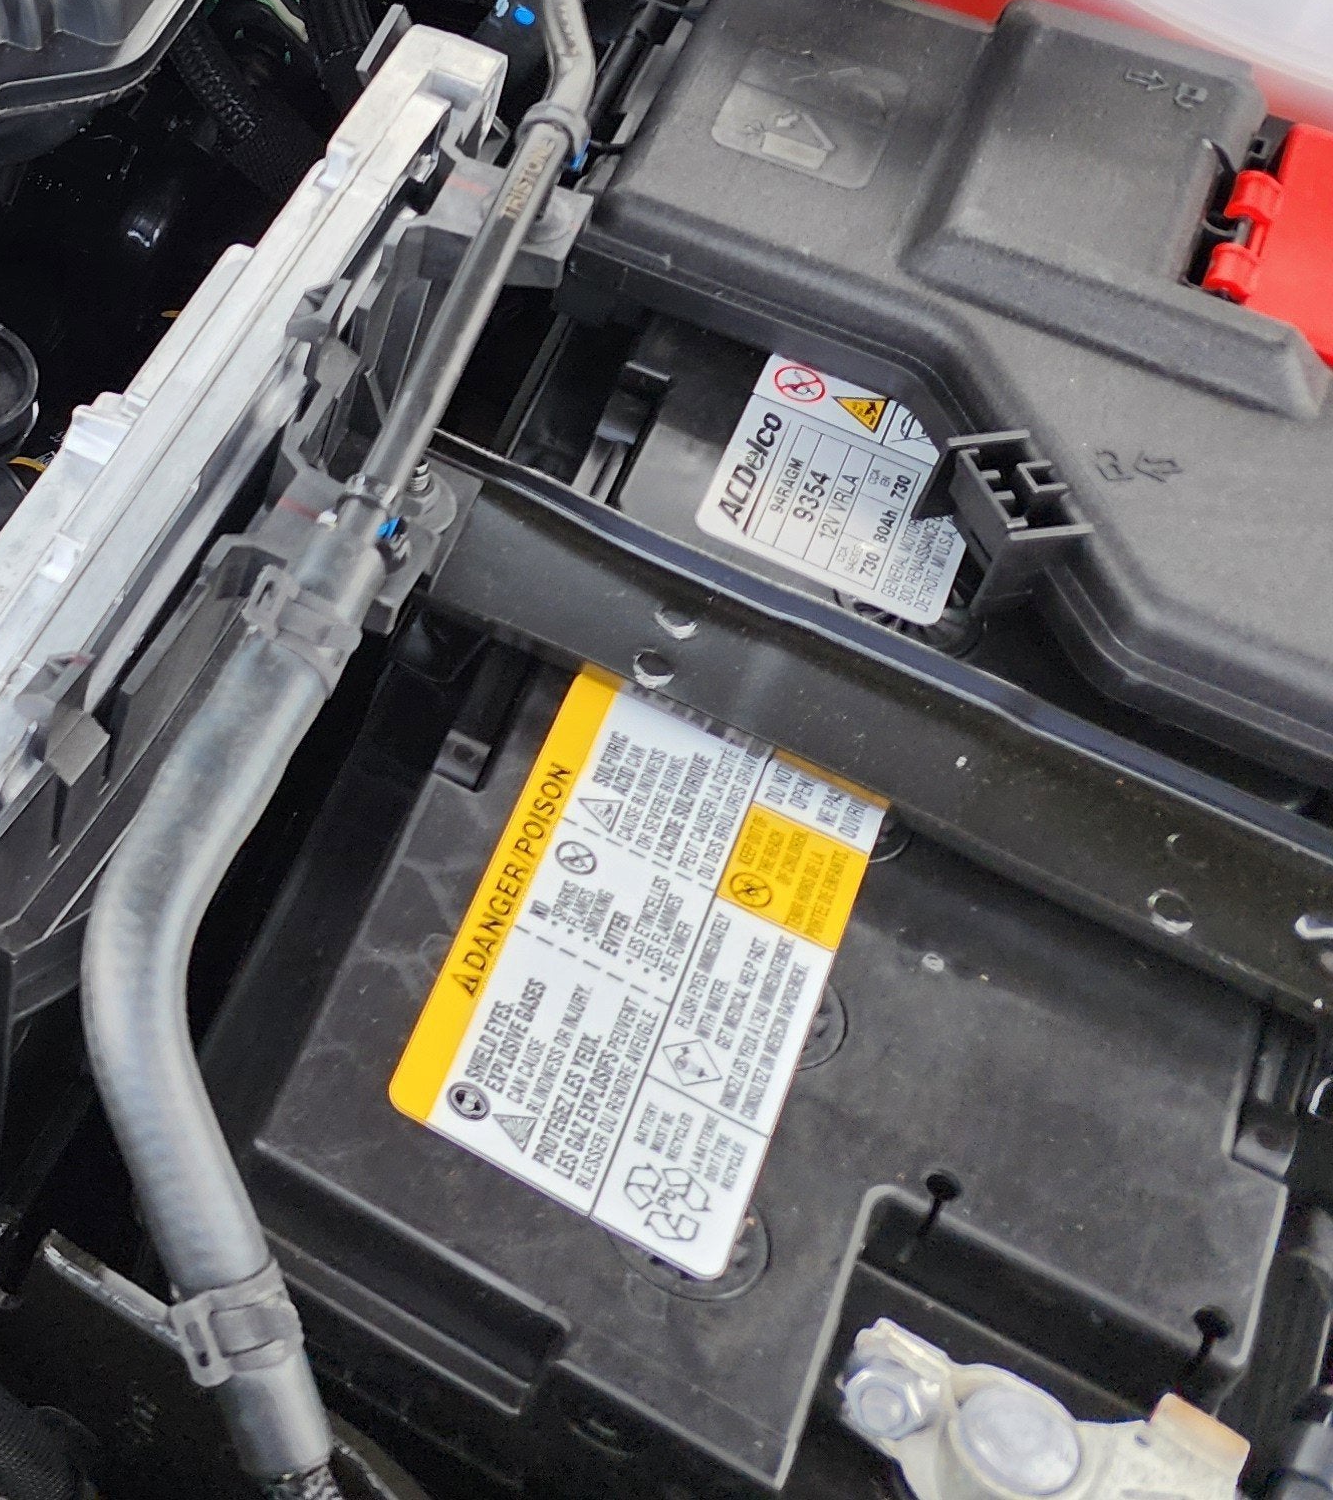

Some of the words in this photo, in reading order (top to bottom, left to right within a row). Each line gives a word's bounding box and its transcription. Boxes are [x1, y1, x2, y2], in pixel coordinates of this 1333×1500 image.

[713, 407, 783, 525] ACDelco
[768, 455, 804, 515] 94RAGM
[791, 467, 831, 524] 9354
[829, 470, 860, 513] VRLA
[889, 472, 912, 502] 730
[818, 514, 842, 542] 12V
[873, 507, 898, 545] 80Ah
[858, 549, 881, 580] 730
[880, 550, 908, 599] GENERAL
[897, 516, 919, 554] MOTOR
[904, 518, 941, 587] RENAISSANCE
[928, 551, 948, 569] MI
[897, 580, 917, 606] 300
[590, 729, 629, 788] SULFURIC
[622, 742, 647, 769] CAN
[733, 749, 760, 786] GRAV
[610, 765, 637, 797] ACID
[615, 803, 644, 842] CAUSE
[630, 746, 668, 808] BLINDNESS
[670, 752, 712, 821] SULFURIQUE
[706, 781, 725, 801] LA
[764, 784, 786, 805] DO
[642, 790, 672, 835] SEVERE
[688, 798, 719, 844] CAUSER
[815, 806, 838, 827] NE
[837, 796, 868, 840] OUVRI
[635, 830, 656, 851] OR
[677, 840, 702, 872] PEUT
[702, 838, 725, 864] DES
[462, 761, 572, 973] DANGER/POISON
[696, 860, 717, 881] OU
[549, 879, 580, 922] SPARKS
[565, 886, 596, 930] FLAMES
[582, 888, 615, 938] SMOKING
[650, 892, 685, 947] FLAMMES
[624, 935, 647, 960] LES
[641, 943, 664, 970] LES
[665, 918, 694, 961] FUMER
[658, 955, 679, 978] DE
[686, 970, 709, 999] EYES
[737, 959, 760, 989] HELP
[606, 995, 642, 1053] PEUVENT
[674, 994, 699, 1031] FLUSH
[694, 1010, 717, 1041] WITH
[721, 984, 751, 1030] MEDICAL
[463, 1032, 500, 1085] SHIELD
[483, 995, 515, 1038] EYES.
[483, 1018, 530, 1095] EXPLOSIVE
[513, 976, 547, 1023] GASES
[714, 1026, 735, 1051] GET
[516, 1035, 547, 1079] CAUSE
[524, 1045, 567, 1117] BLINDNESS
[552, 1026, 574, 1050] OR
[505, 1075, 530, 1106] CAN
[559, 1067, 586, 1099] LES
[575, 1047, 620, 1125] EXPLOSIFS
[604, 1060, 639, 1115] RENDRE
[563, 1118, 592, 1154] GAZ
[596, 1110, 619, 1135] OU
[552, 1147, 580, 1181] LES
[574, 1130, 611, 1192] BLESSER
[656, 1186, 677, 1211] Pb
